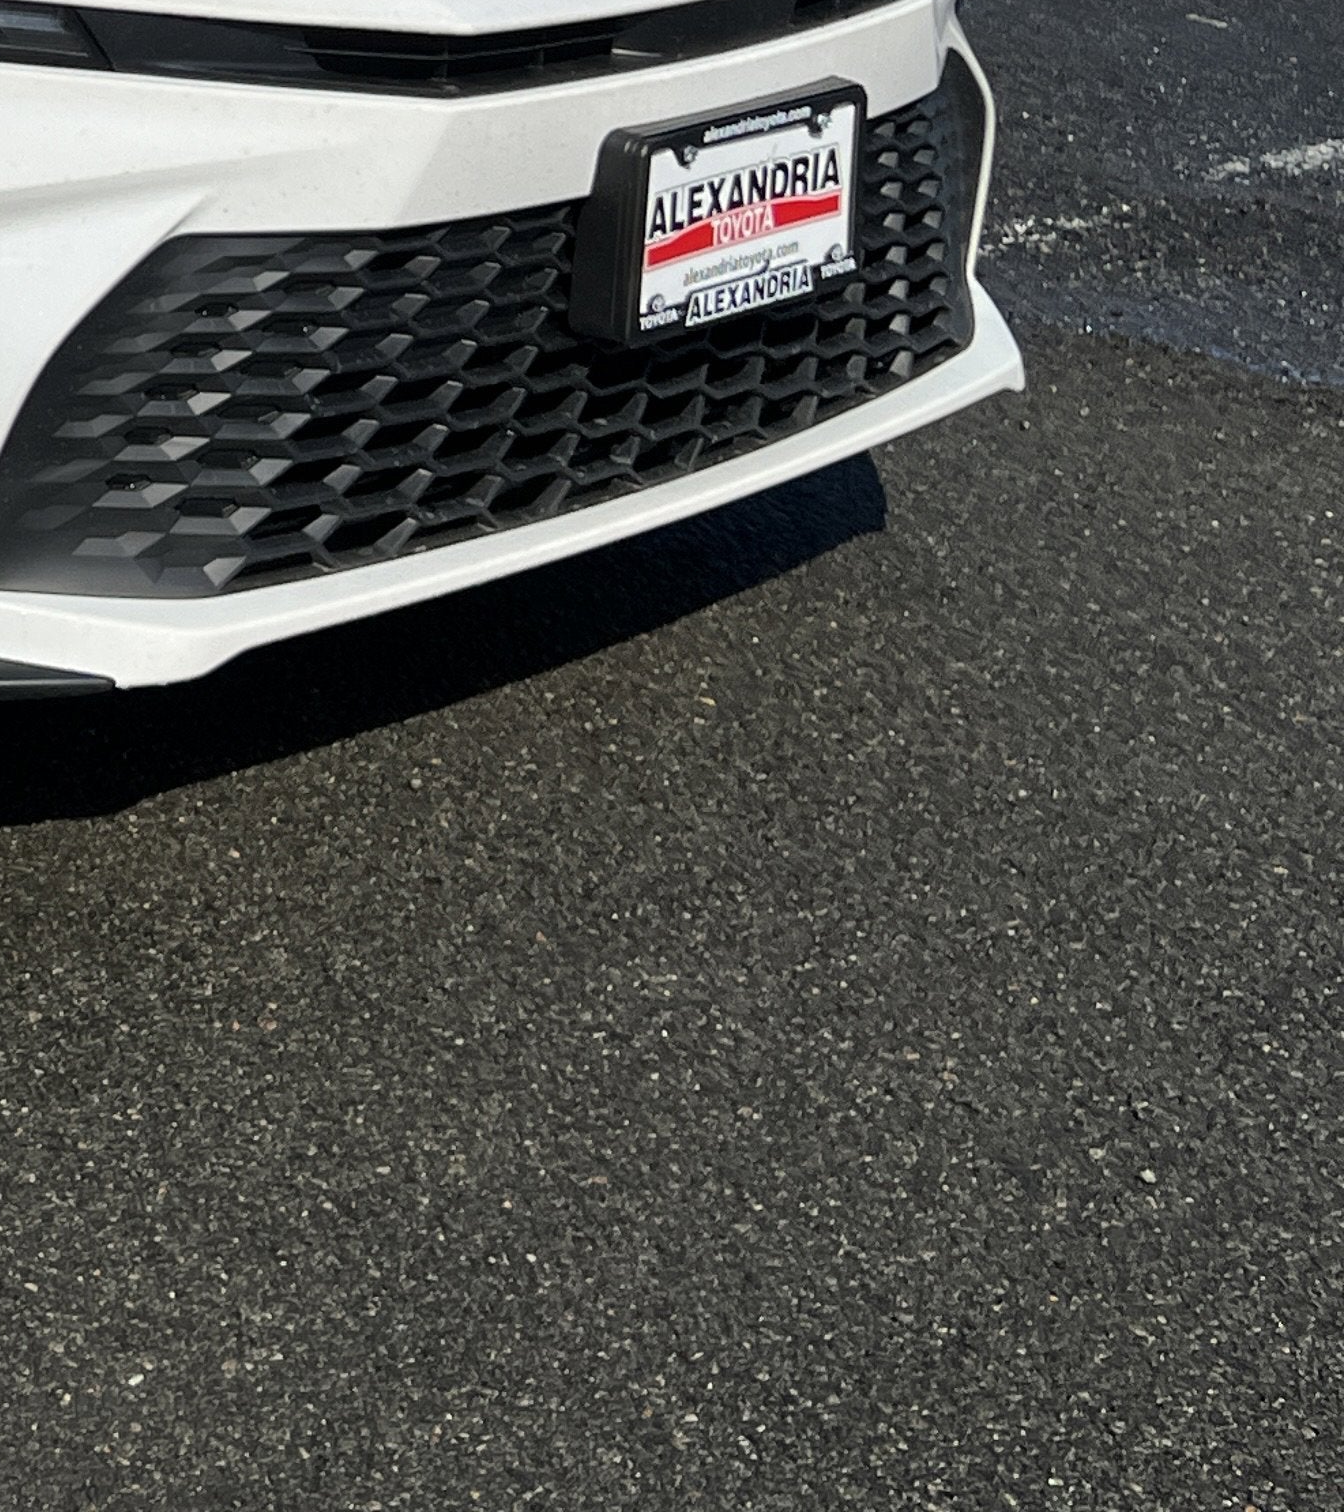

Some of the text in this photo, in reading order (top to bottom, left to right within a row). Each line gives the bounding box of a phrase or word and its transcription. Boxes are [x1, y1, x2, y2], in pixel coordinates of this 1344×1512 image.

[648, 148, 840, 240] ALEXANDRIA
[710, 205, 775, 244] TOYOTA
[638, 257, 857, 331] TOYOTA ALEXANDRIA TOYOTA
[682, 241, 800, 287] alexandriatoyota.com
